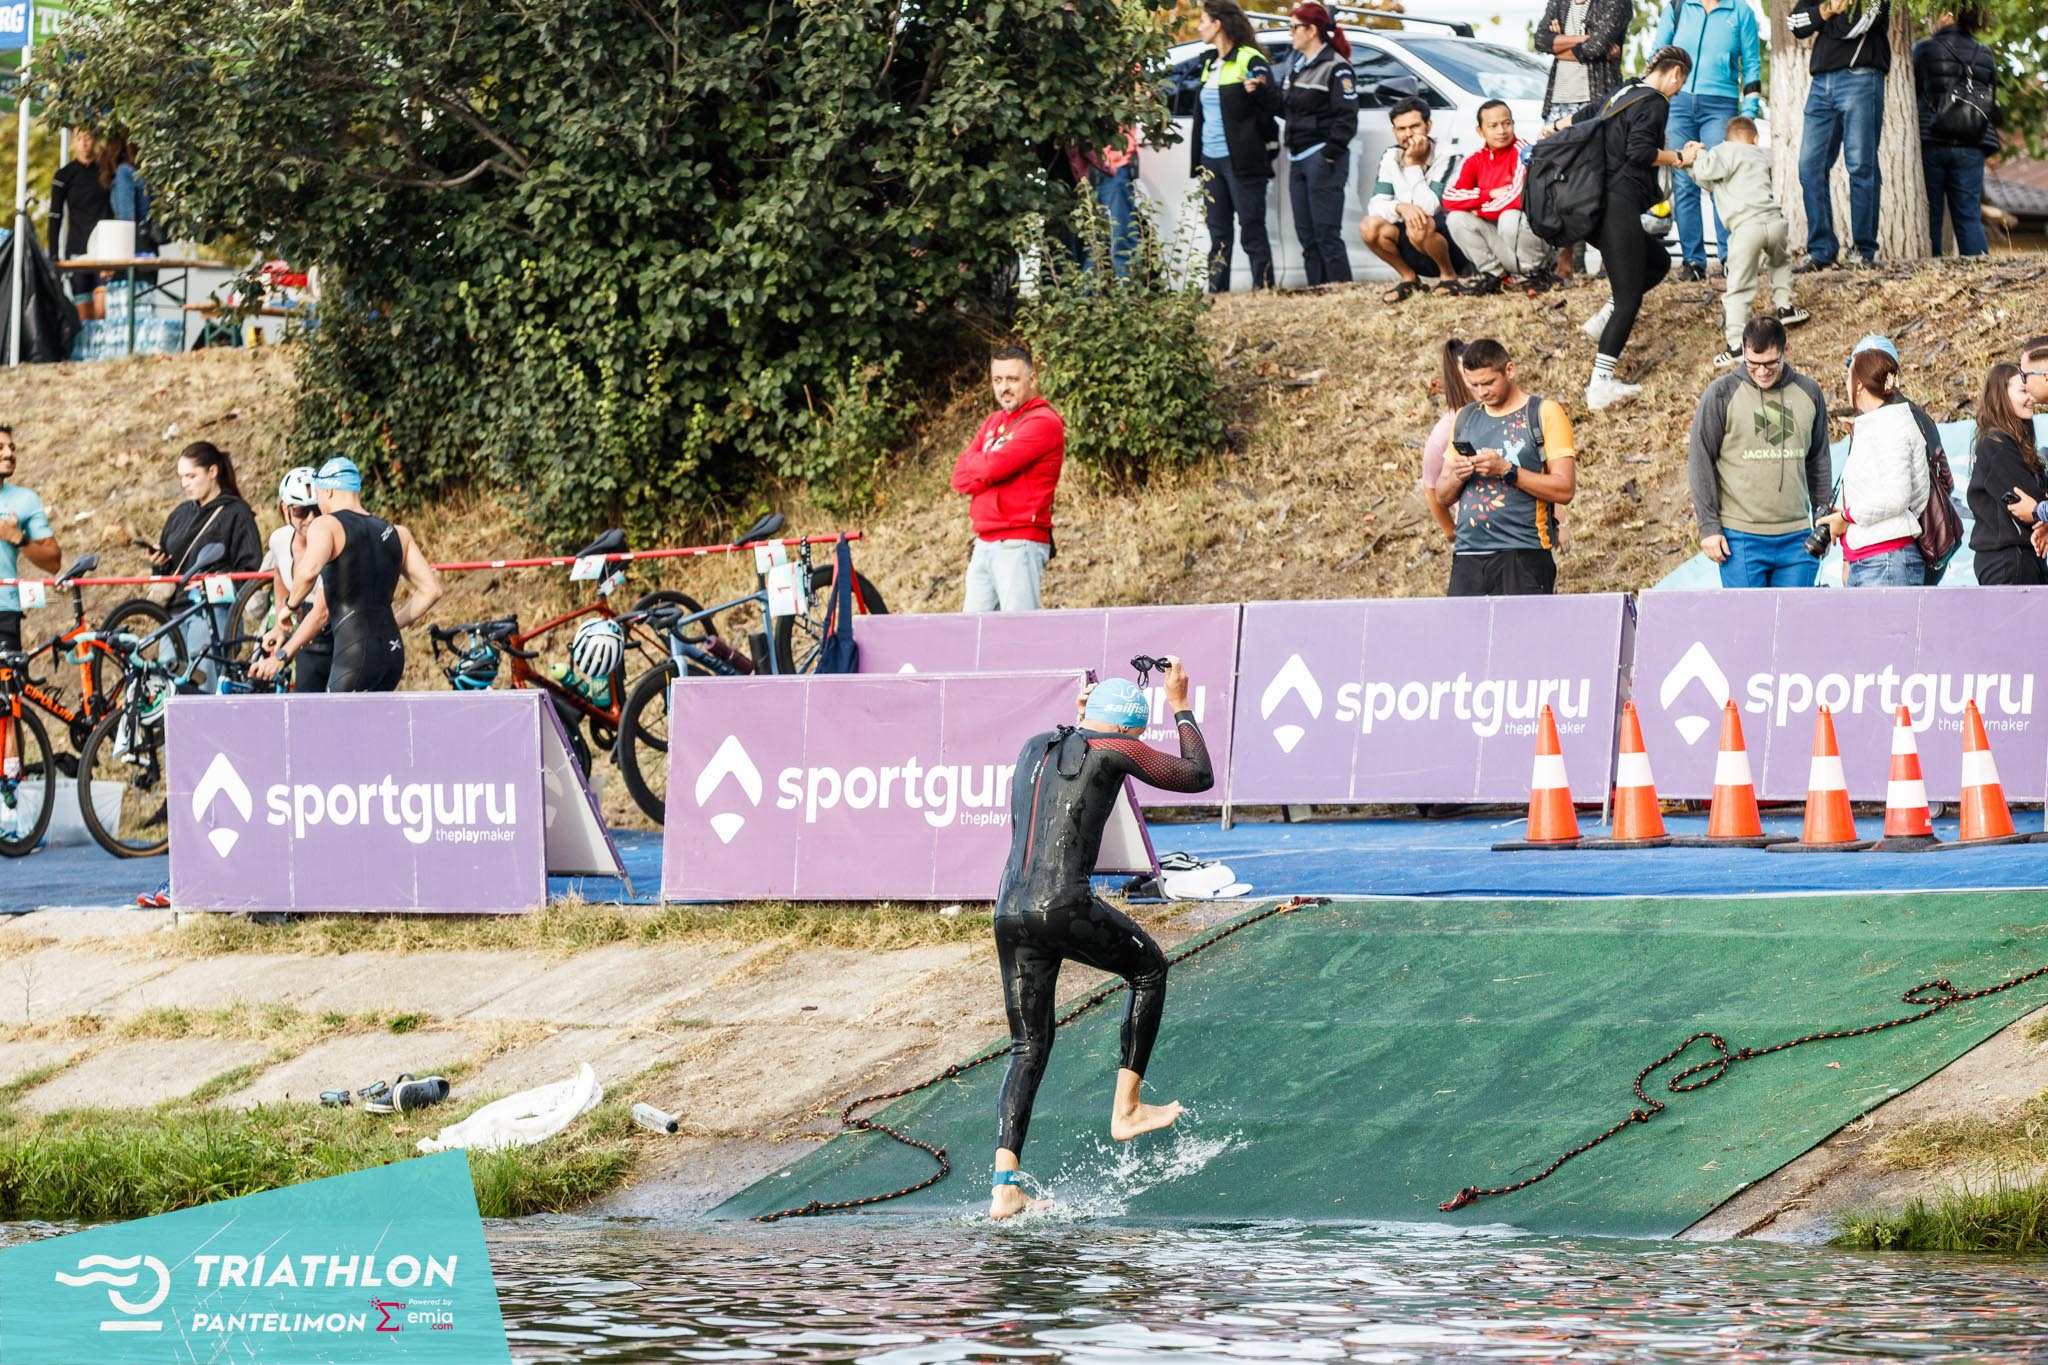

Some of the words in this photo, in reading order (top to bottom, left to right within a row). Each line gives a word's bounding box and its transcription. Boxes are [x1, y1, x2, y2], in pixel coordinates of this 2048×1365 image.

[582, 561, 593, 574] 2
[28, 588, 36, 602] 5
[215, 584, 225, 597] 4
[1335, 671, 1591, 737] sportguru
[1745, 663, 2035, 733] sportguru
[1103, 702, 1149, 717] sailfish
[776, 755, 1017, 828] sportgur
[266, 774, 517, 844] sportguru
[436, 828, 516, 843] theplaymaker
